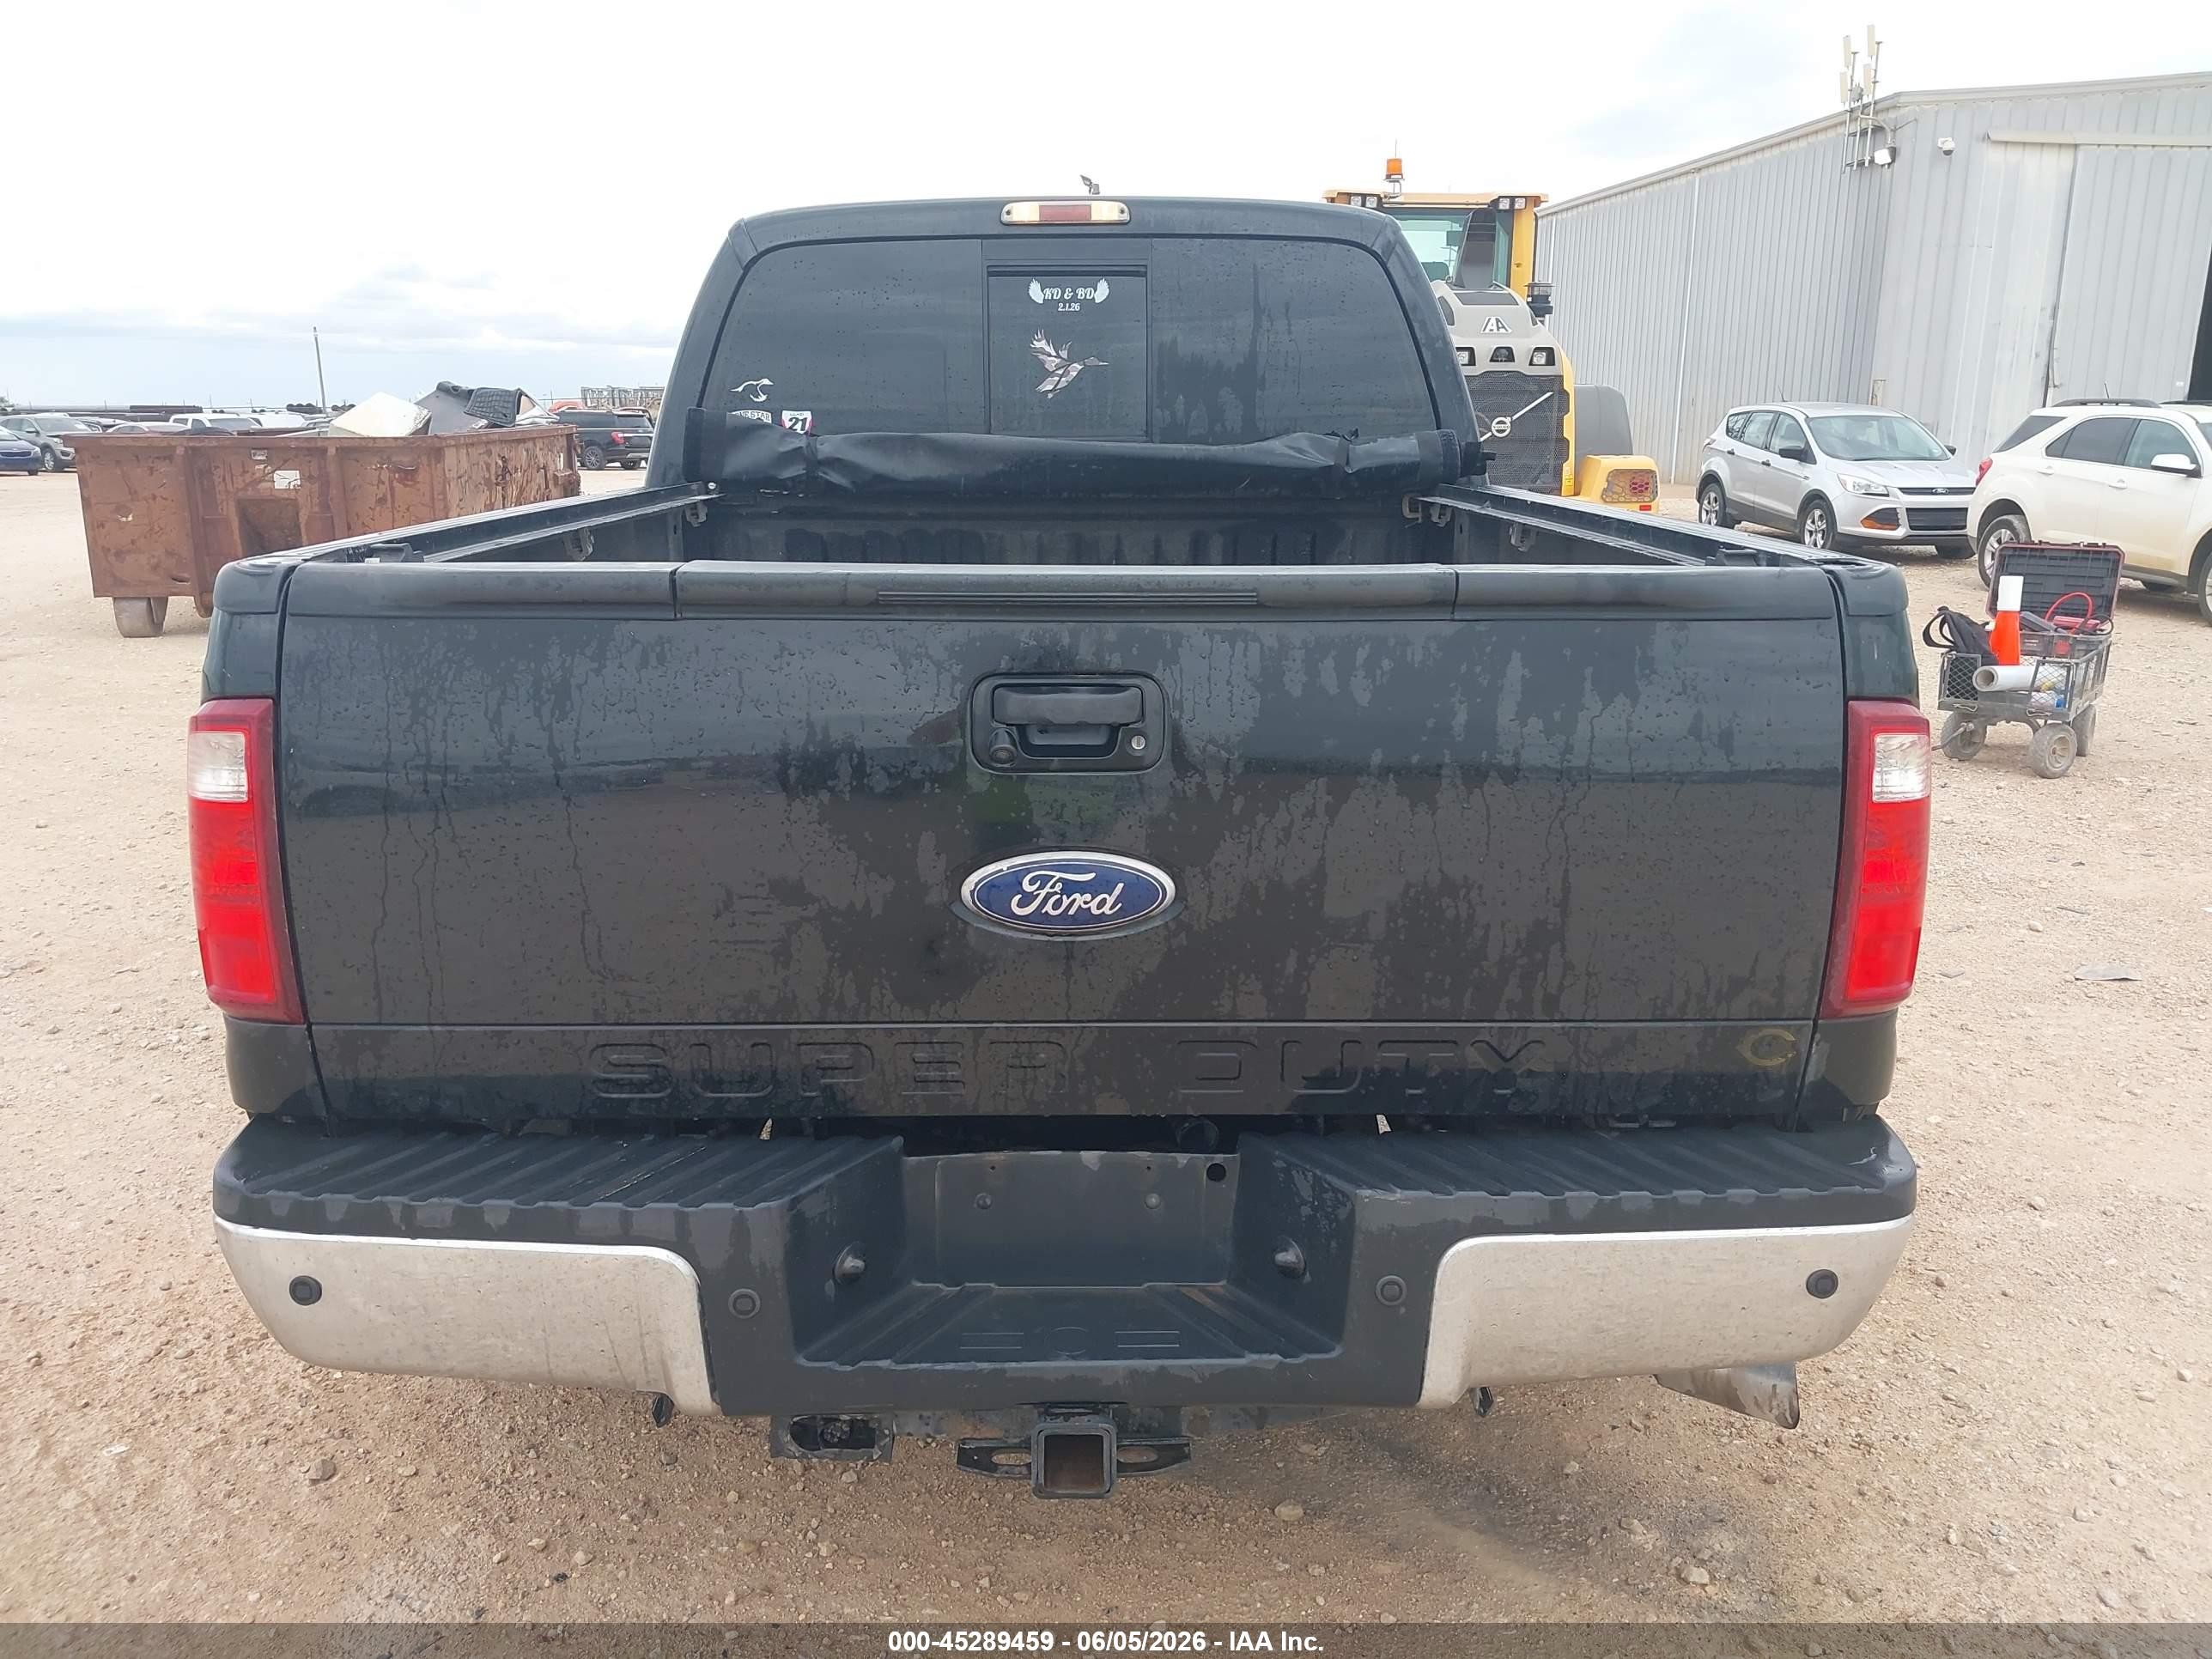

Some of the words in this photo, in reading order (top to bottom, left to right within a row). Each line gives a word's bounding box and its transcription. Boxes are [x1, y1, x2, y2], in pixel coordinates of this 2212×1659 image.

[1063, 287, 1074, 301] &
[1075, 287, 1095, 301] BD
[1057, 302, 1081, 312] 2.1.26
[750, 411, 770, 422] STAR
[788, 416, 808, 431] 21
[1011, 870, 1125, 916] Ford
[588, 1040, 1070, 1100] SUPER
[1174, 1038, 1547, 1097] DUTY
